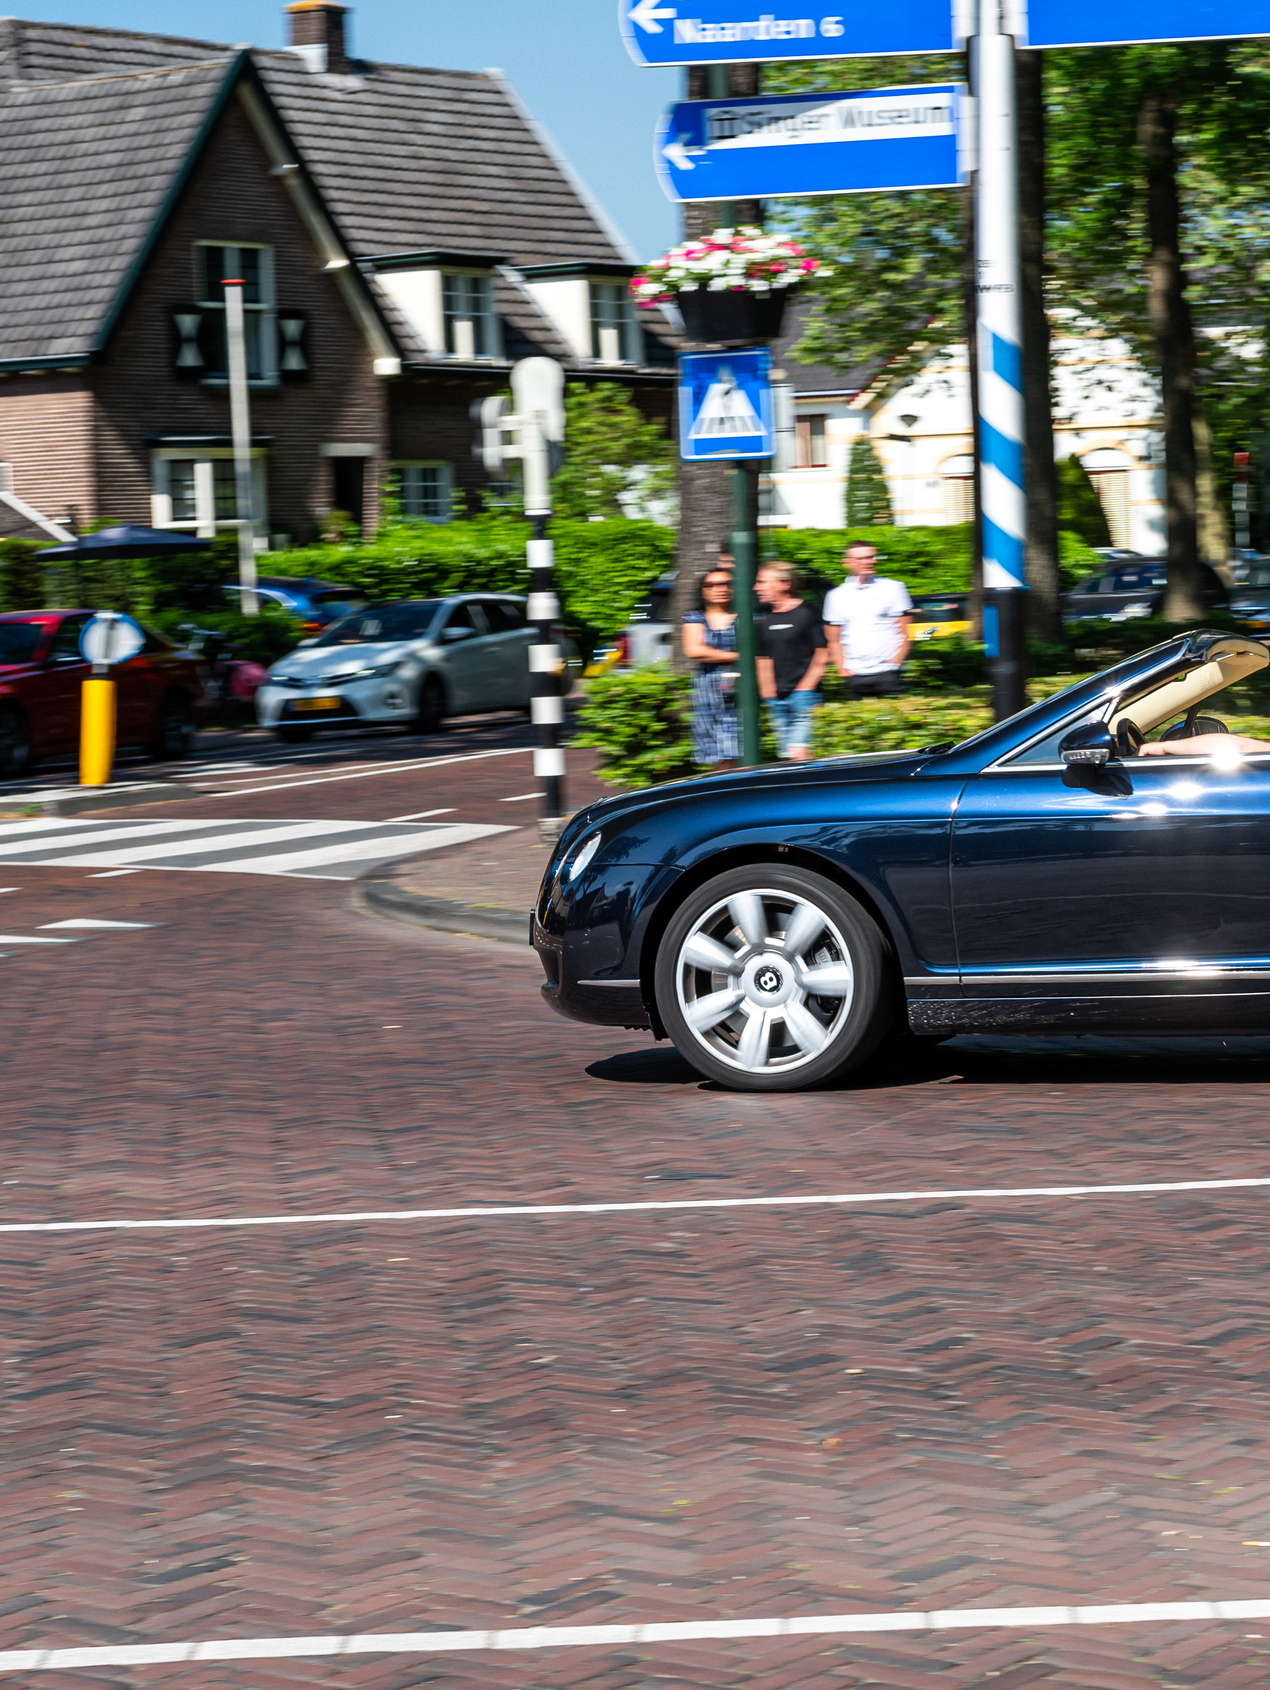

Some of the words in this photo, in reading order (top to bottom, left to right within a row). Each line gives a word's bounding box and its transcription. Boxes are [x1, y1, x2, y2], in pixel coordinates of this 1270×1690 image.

[674, 15, 816, 44] Naarden
[819, 16, 845, 38] 6
[742, 110, 832, 139] Singer
[836, 104, 951, 129] Museum
[760, 971, 778, 990] B
